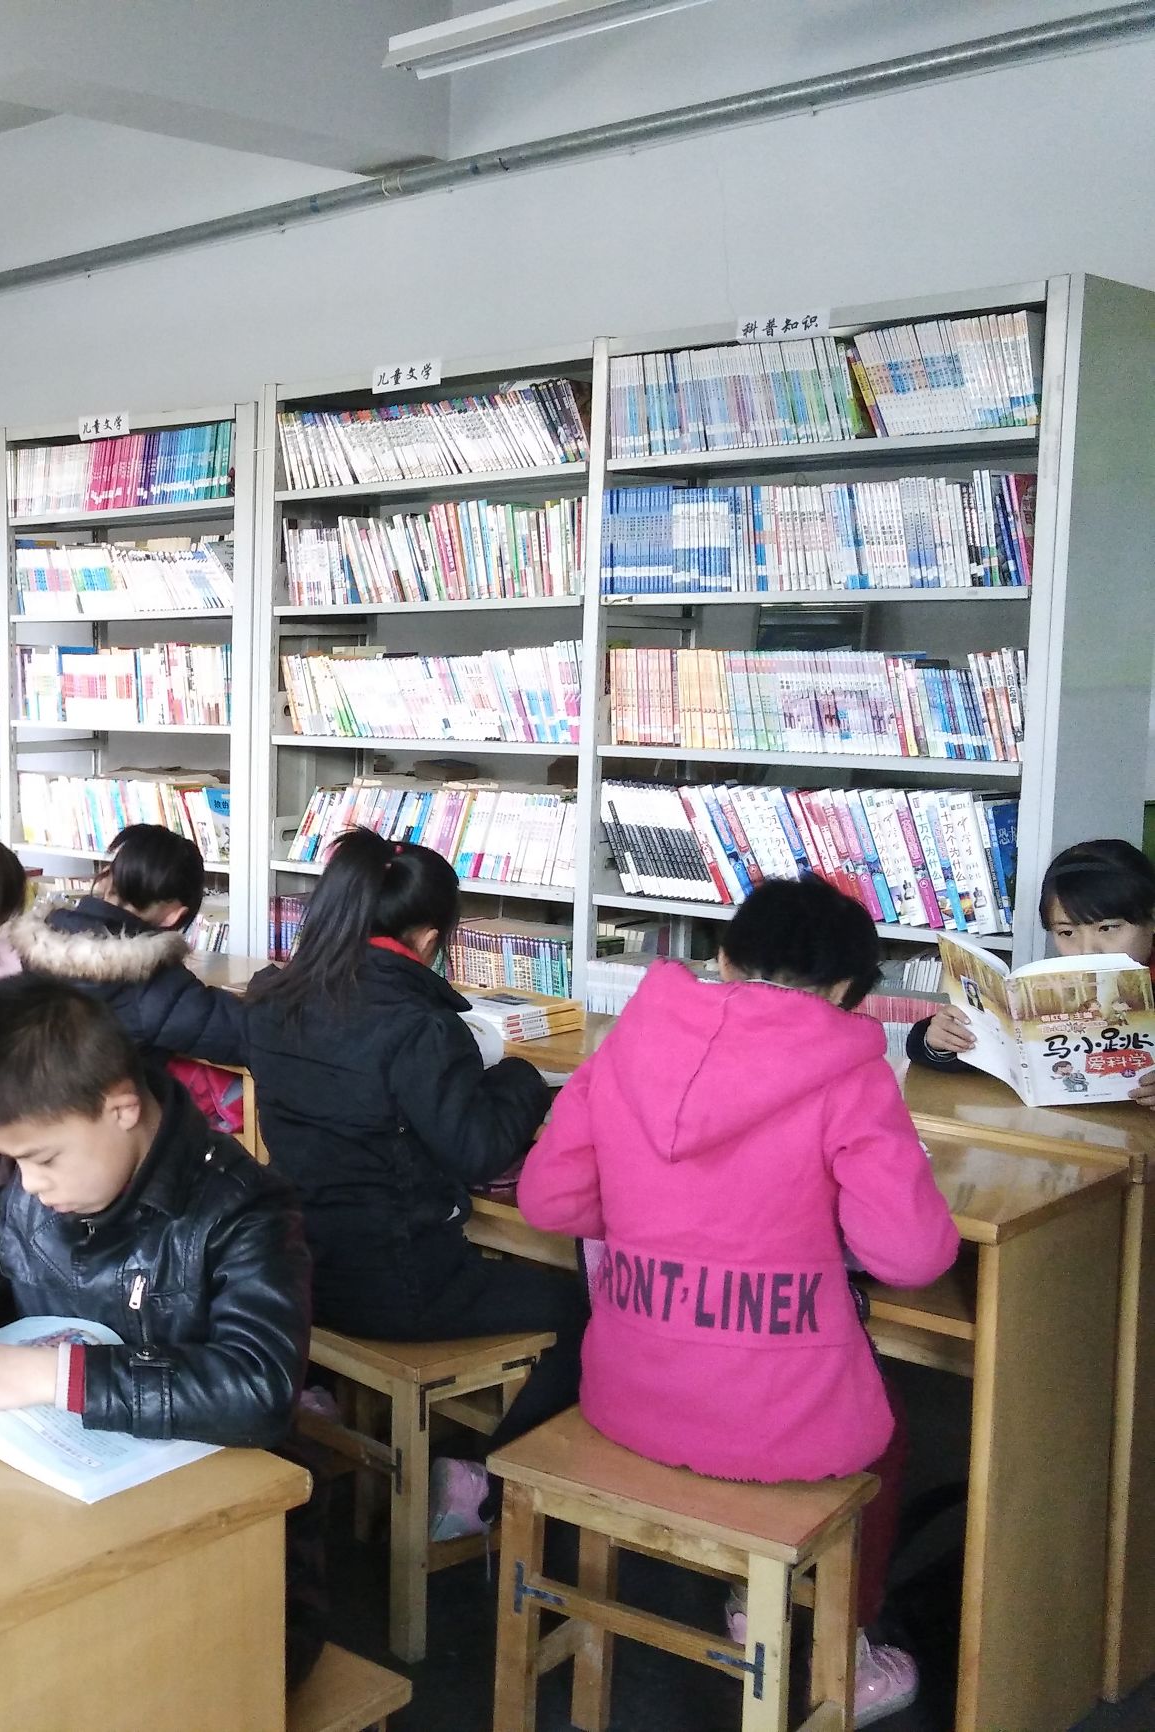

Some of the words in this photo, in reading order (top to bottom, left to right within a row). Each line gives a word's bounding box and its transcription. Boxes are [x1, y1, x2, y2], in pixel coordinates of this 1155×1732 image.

[742, 315, 819, 340] 科普知识
[377, 362, 433, 387] 儿童文学
[82, 415, 122, 435] 儿童文学
[915, 811, 943, 881] 十万个为什么
[941, 811, 966, 881] 十万个为什么
[1043, 1028, 1154, 1059] 马小跳
[1087, 1053, 1147, 1071] 爱科学
